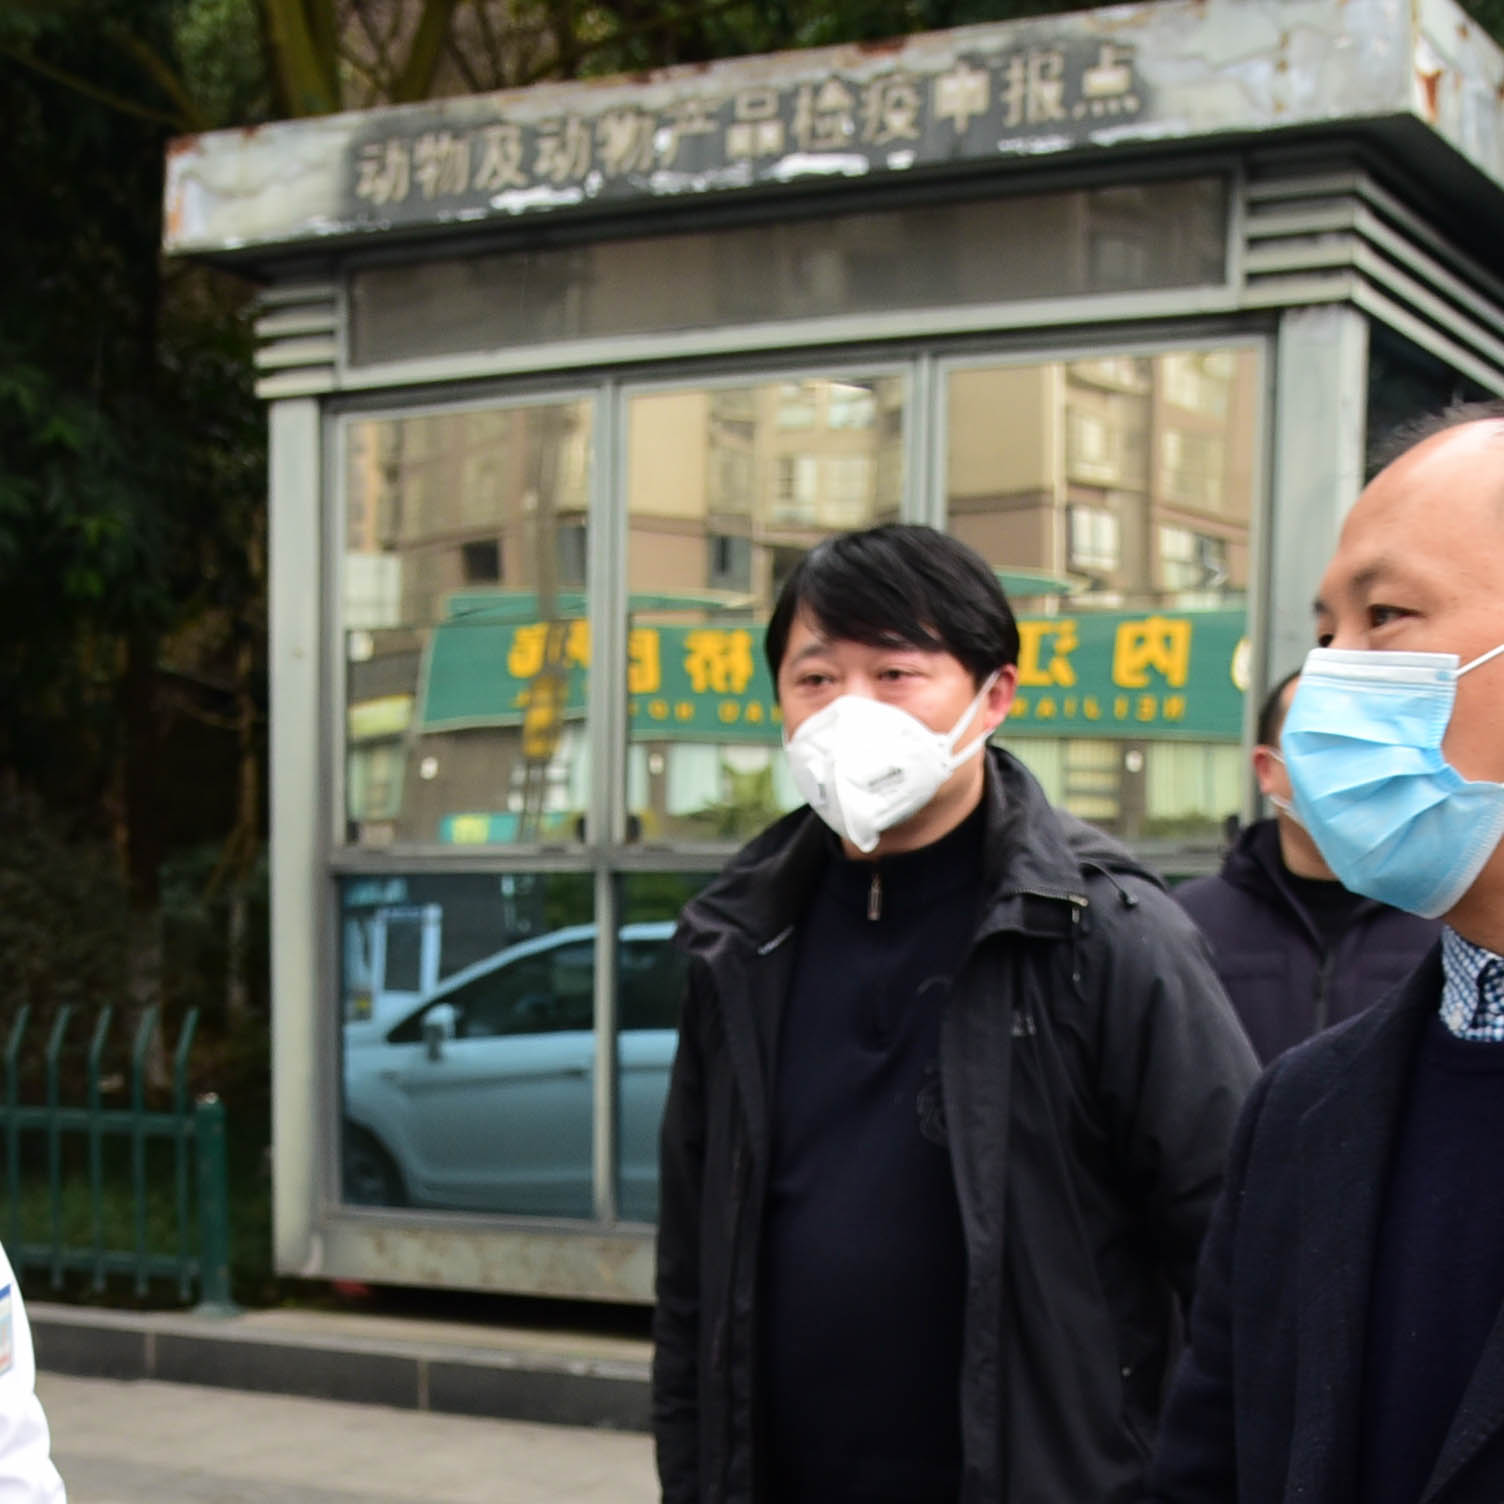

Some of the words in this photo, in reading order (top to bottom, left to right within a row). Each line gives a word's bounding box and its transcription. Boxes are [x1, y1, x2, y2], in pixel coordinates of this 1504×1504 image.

[356, 43, 1139, 203] 动物及动物产品检疫申报点
